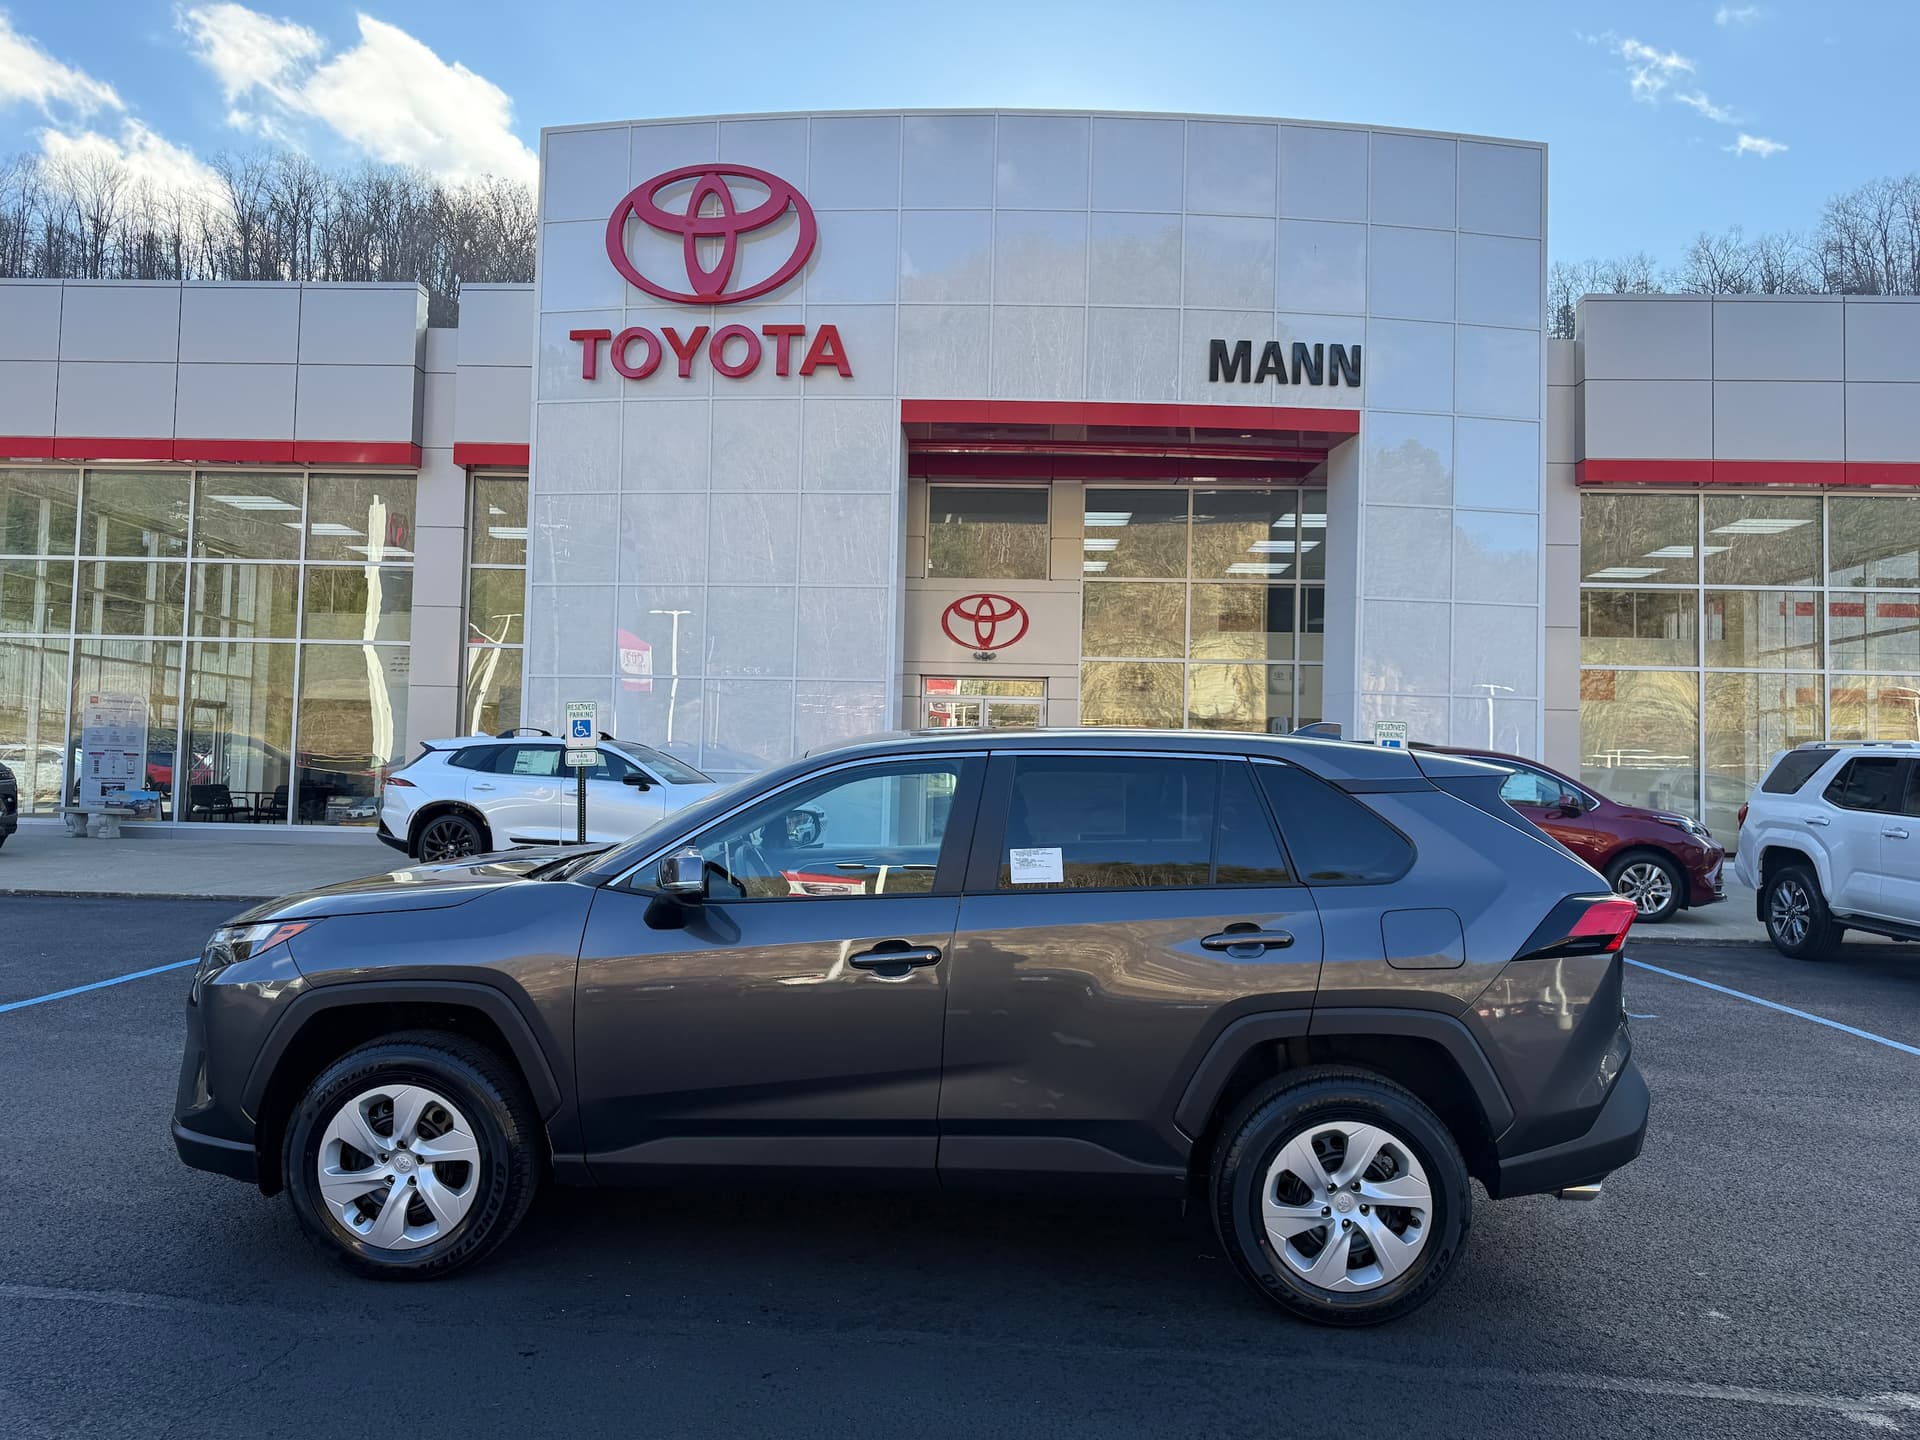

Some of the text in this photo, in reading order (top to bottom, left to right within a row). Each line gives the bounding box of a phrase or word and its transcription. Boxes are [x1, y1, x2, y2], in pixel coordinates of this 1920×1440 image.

[569, 323, 853, 380] TOYOTA
[1209, 339, 1362, 387] MANN
[567, 703, 595, 711] RESERVED
[569, 711, 594, 719] PARKING
[1377, 723, 1406, 732] RESERVED
[1379, 731, 1404, 739] PARKING
